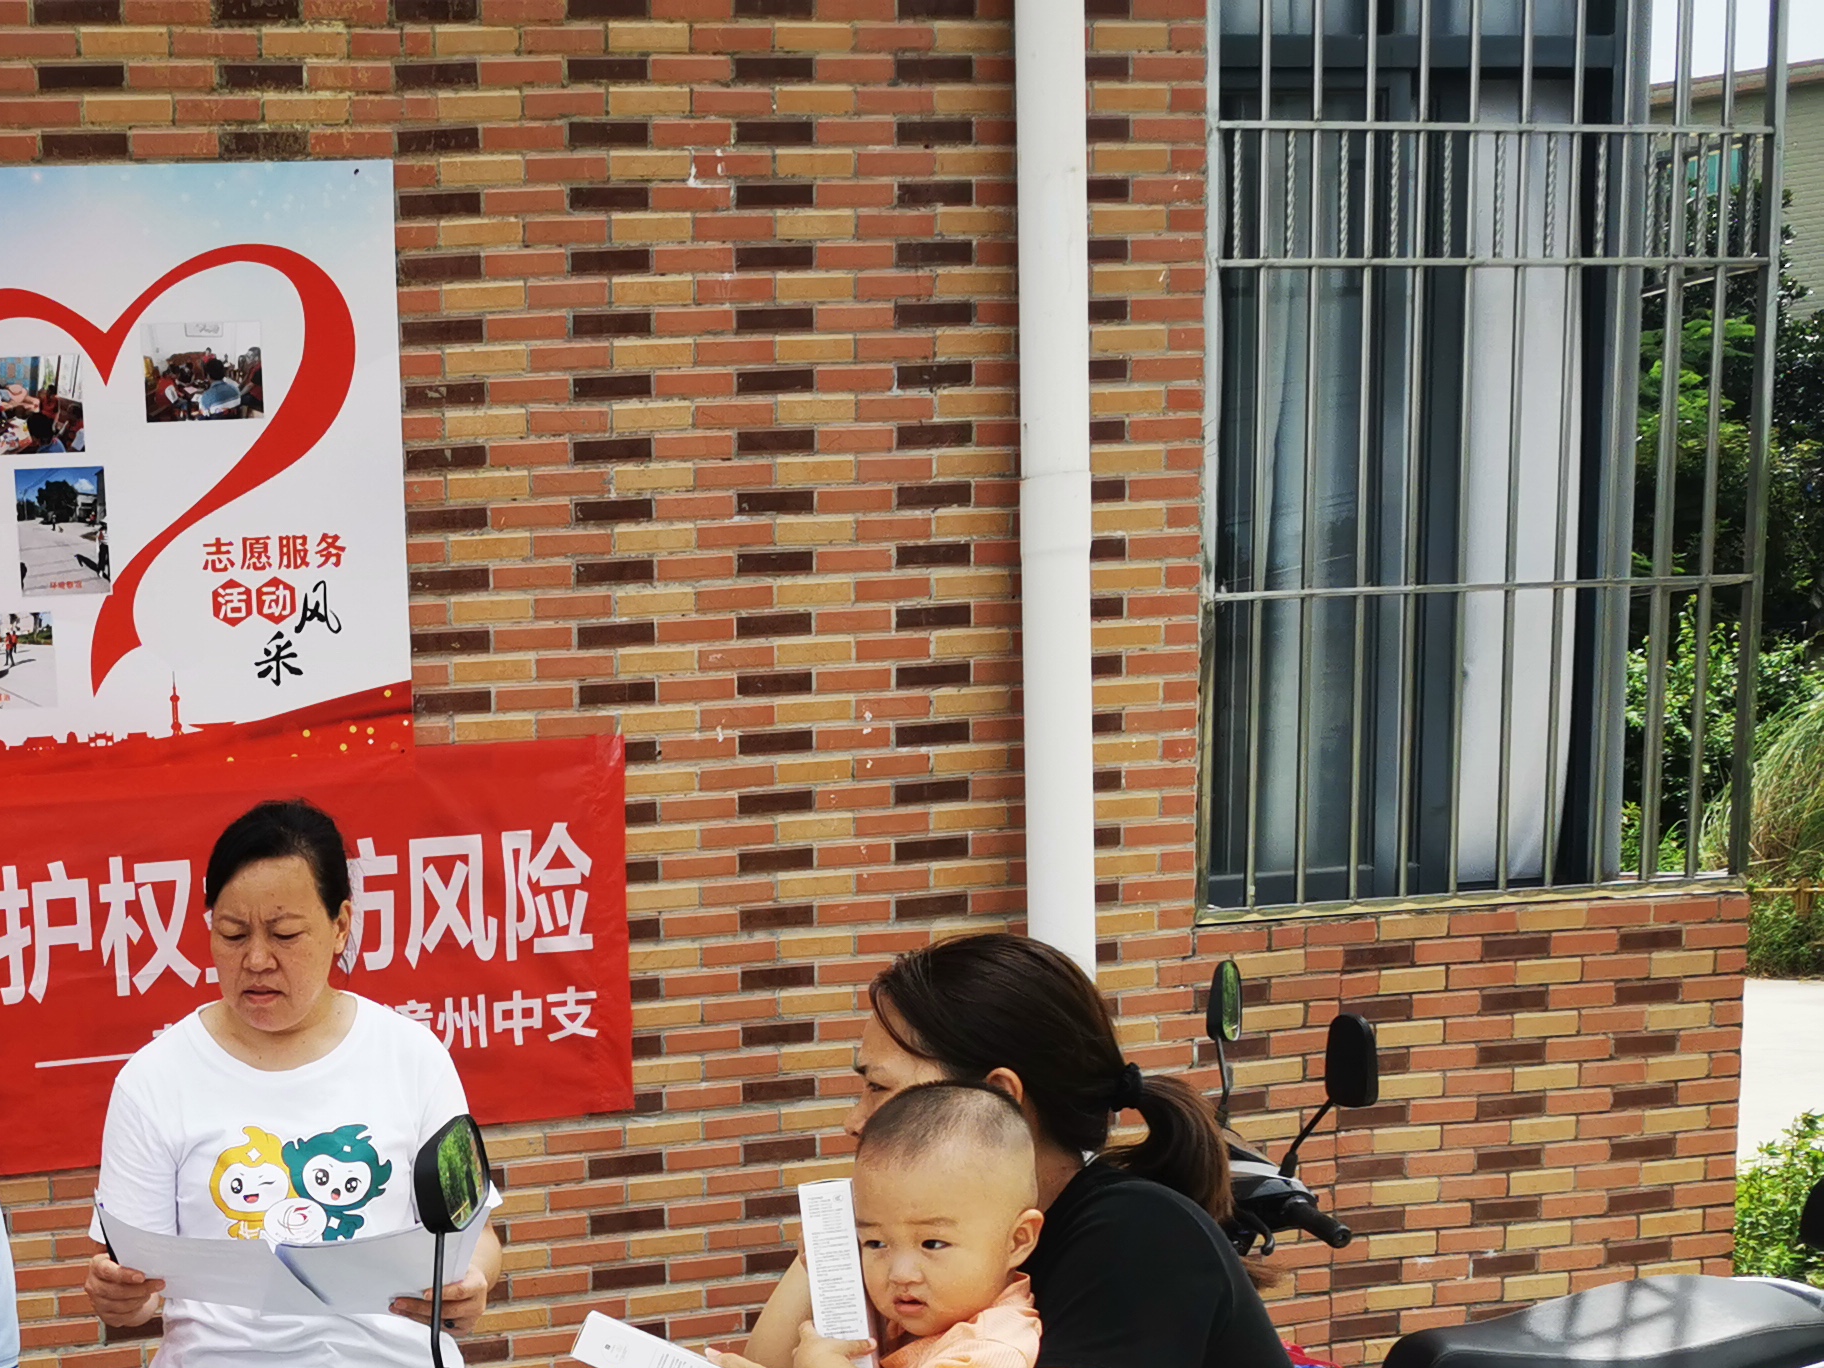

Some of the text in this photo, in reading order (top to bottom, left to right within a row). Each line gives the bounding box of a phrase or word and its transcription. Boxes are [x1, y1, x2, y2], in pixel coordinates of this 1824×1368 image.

[202, 532, 346, 573] 志愿服务
[217, 584, 291, 621] 活动
